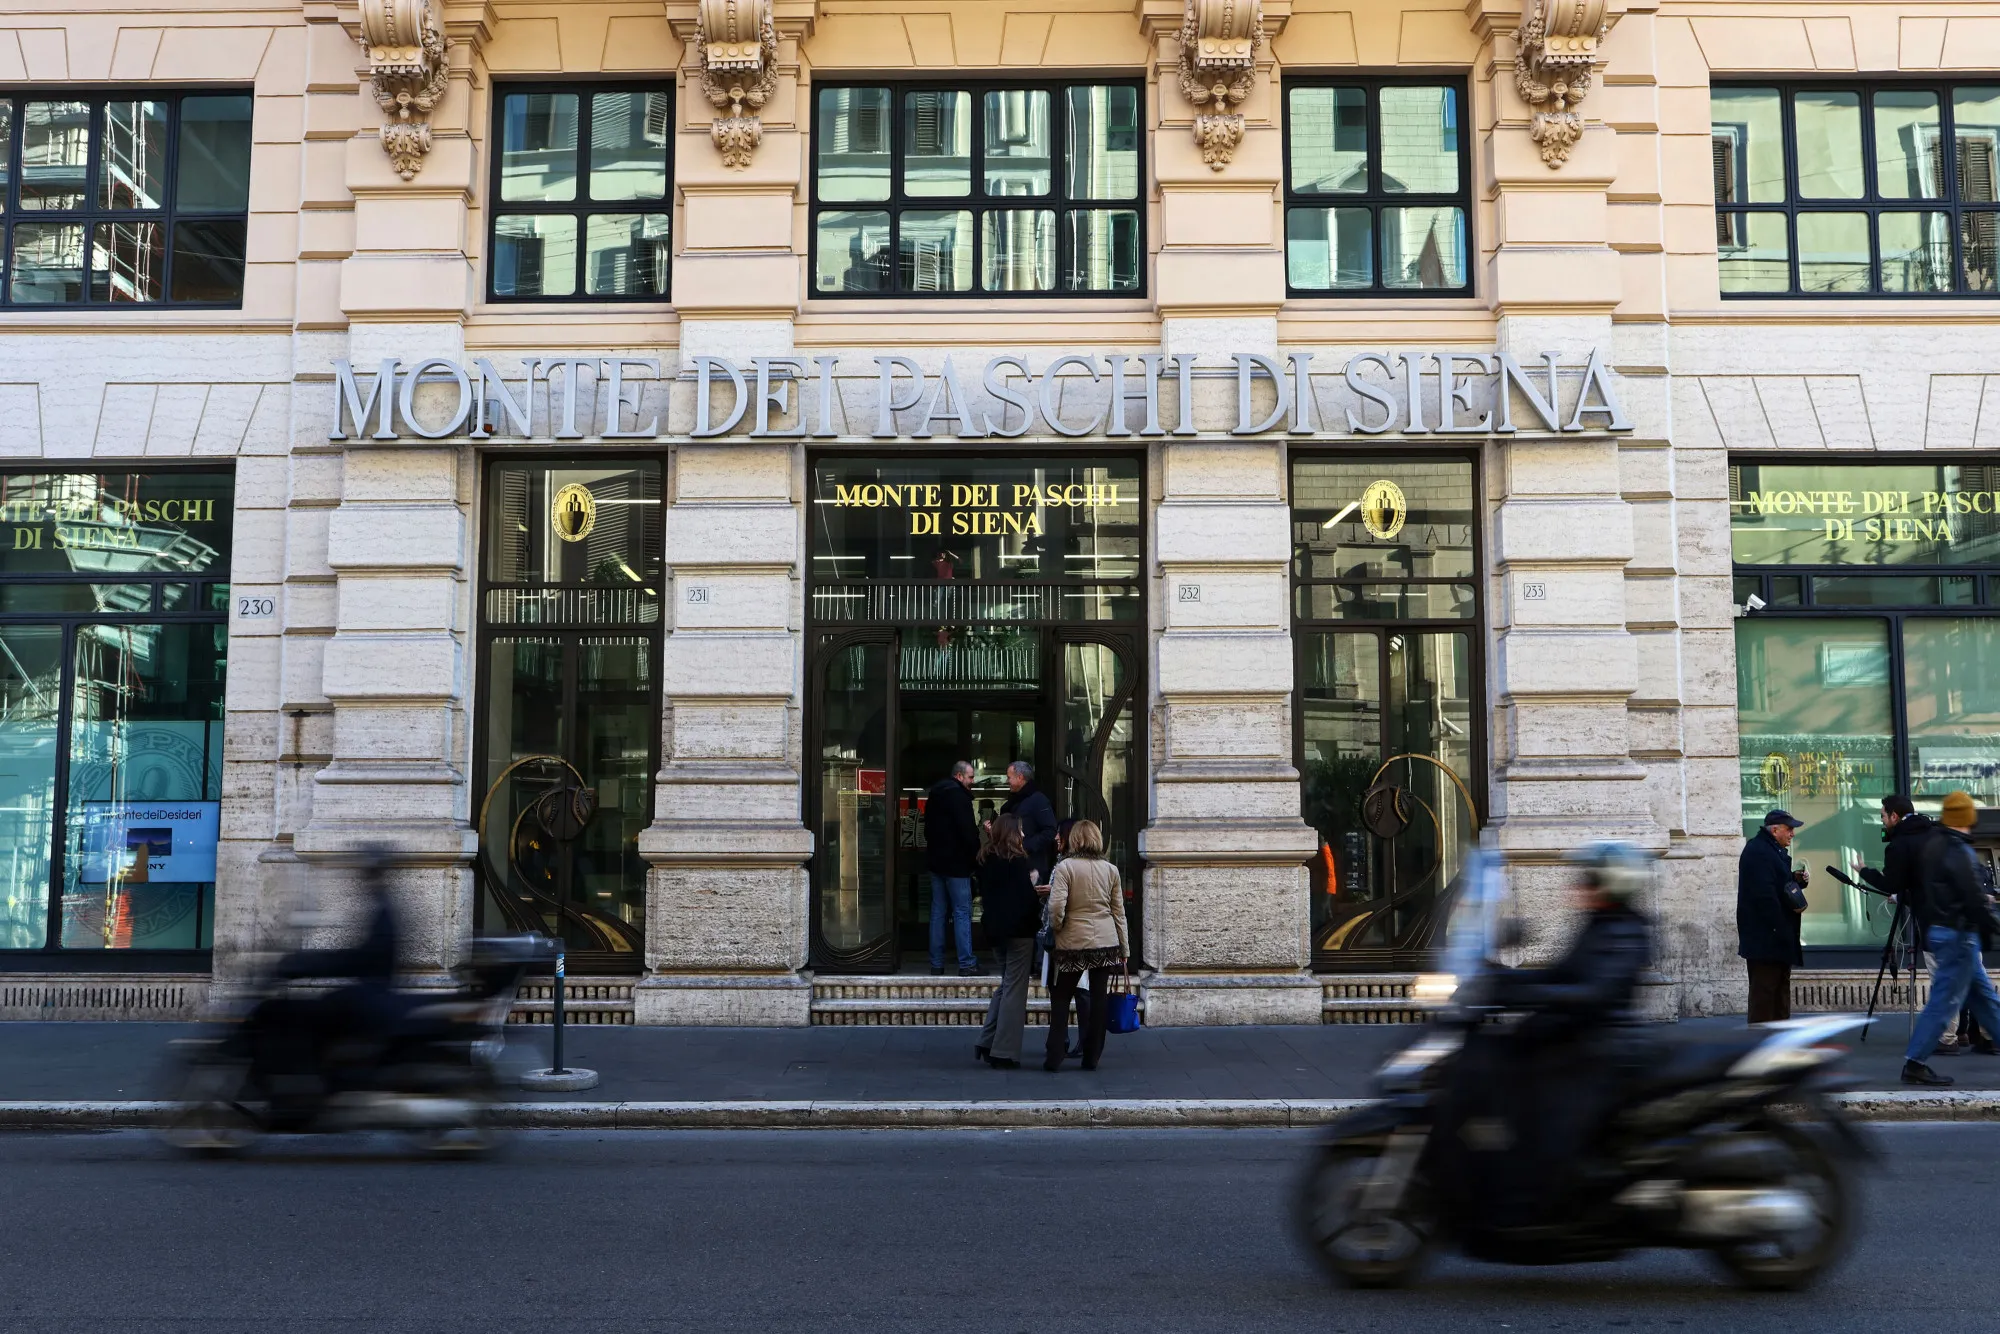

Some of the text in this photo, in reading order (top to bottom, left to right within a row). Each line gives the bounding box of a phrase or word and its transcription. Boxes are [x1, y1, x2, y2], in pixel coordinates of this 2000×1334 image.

[327, 346, 1636, 440] MONTE DEI PASCHI DI SIENA
[834, 484, 1120, 507] MONTE DEI PASCHI
[1748, 491, 1854, 514] MONTE
[1861, 491, 1911, 514] DEI
[53, 500, 103, 522] DEI
[114, 499, 215, 522] PASCHI
[910, 511, 1044, 535] DI SIENA
[1824, 518, 1955, 541] DI SIENA
[12, 527, 140, 550] DI SIENA
[689, 589, 706, 602] 231
[1181, 586, 1199, 600] 232
[1525, 585, 1544, 599] 233
[240, 599, 274, 616] 230
[1799, 775, 1814, 786] DI
